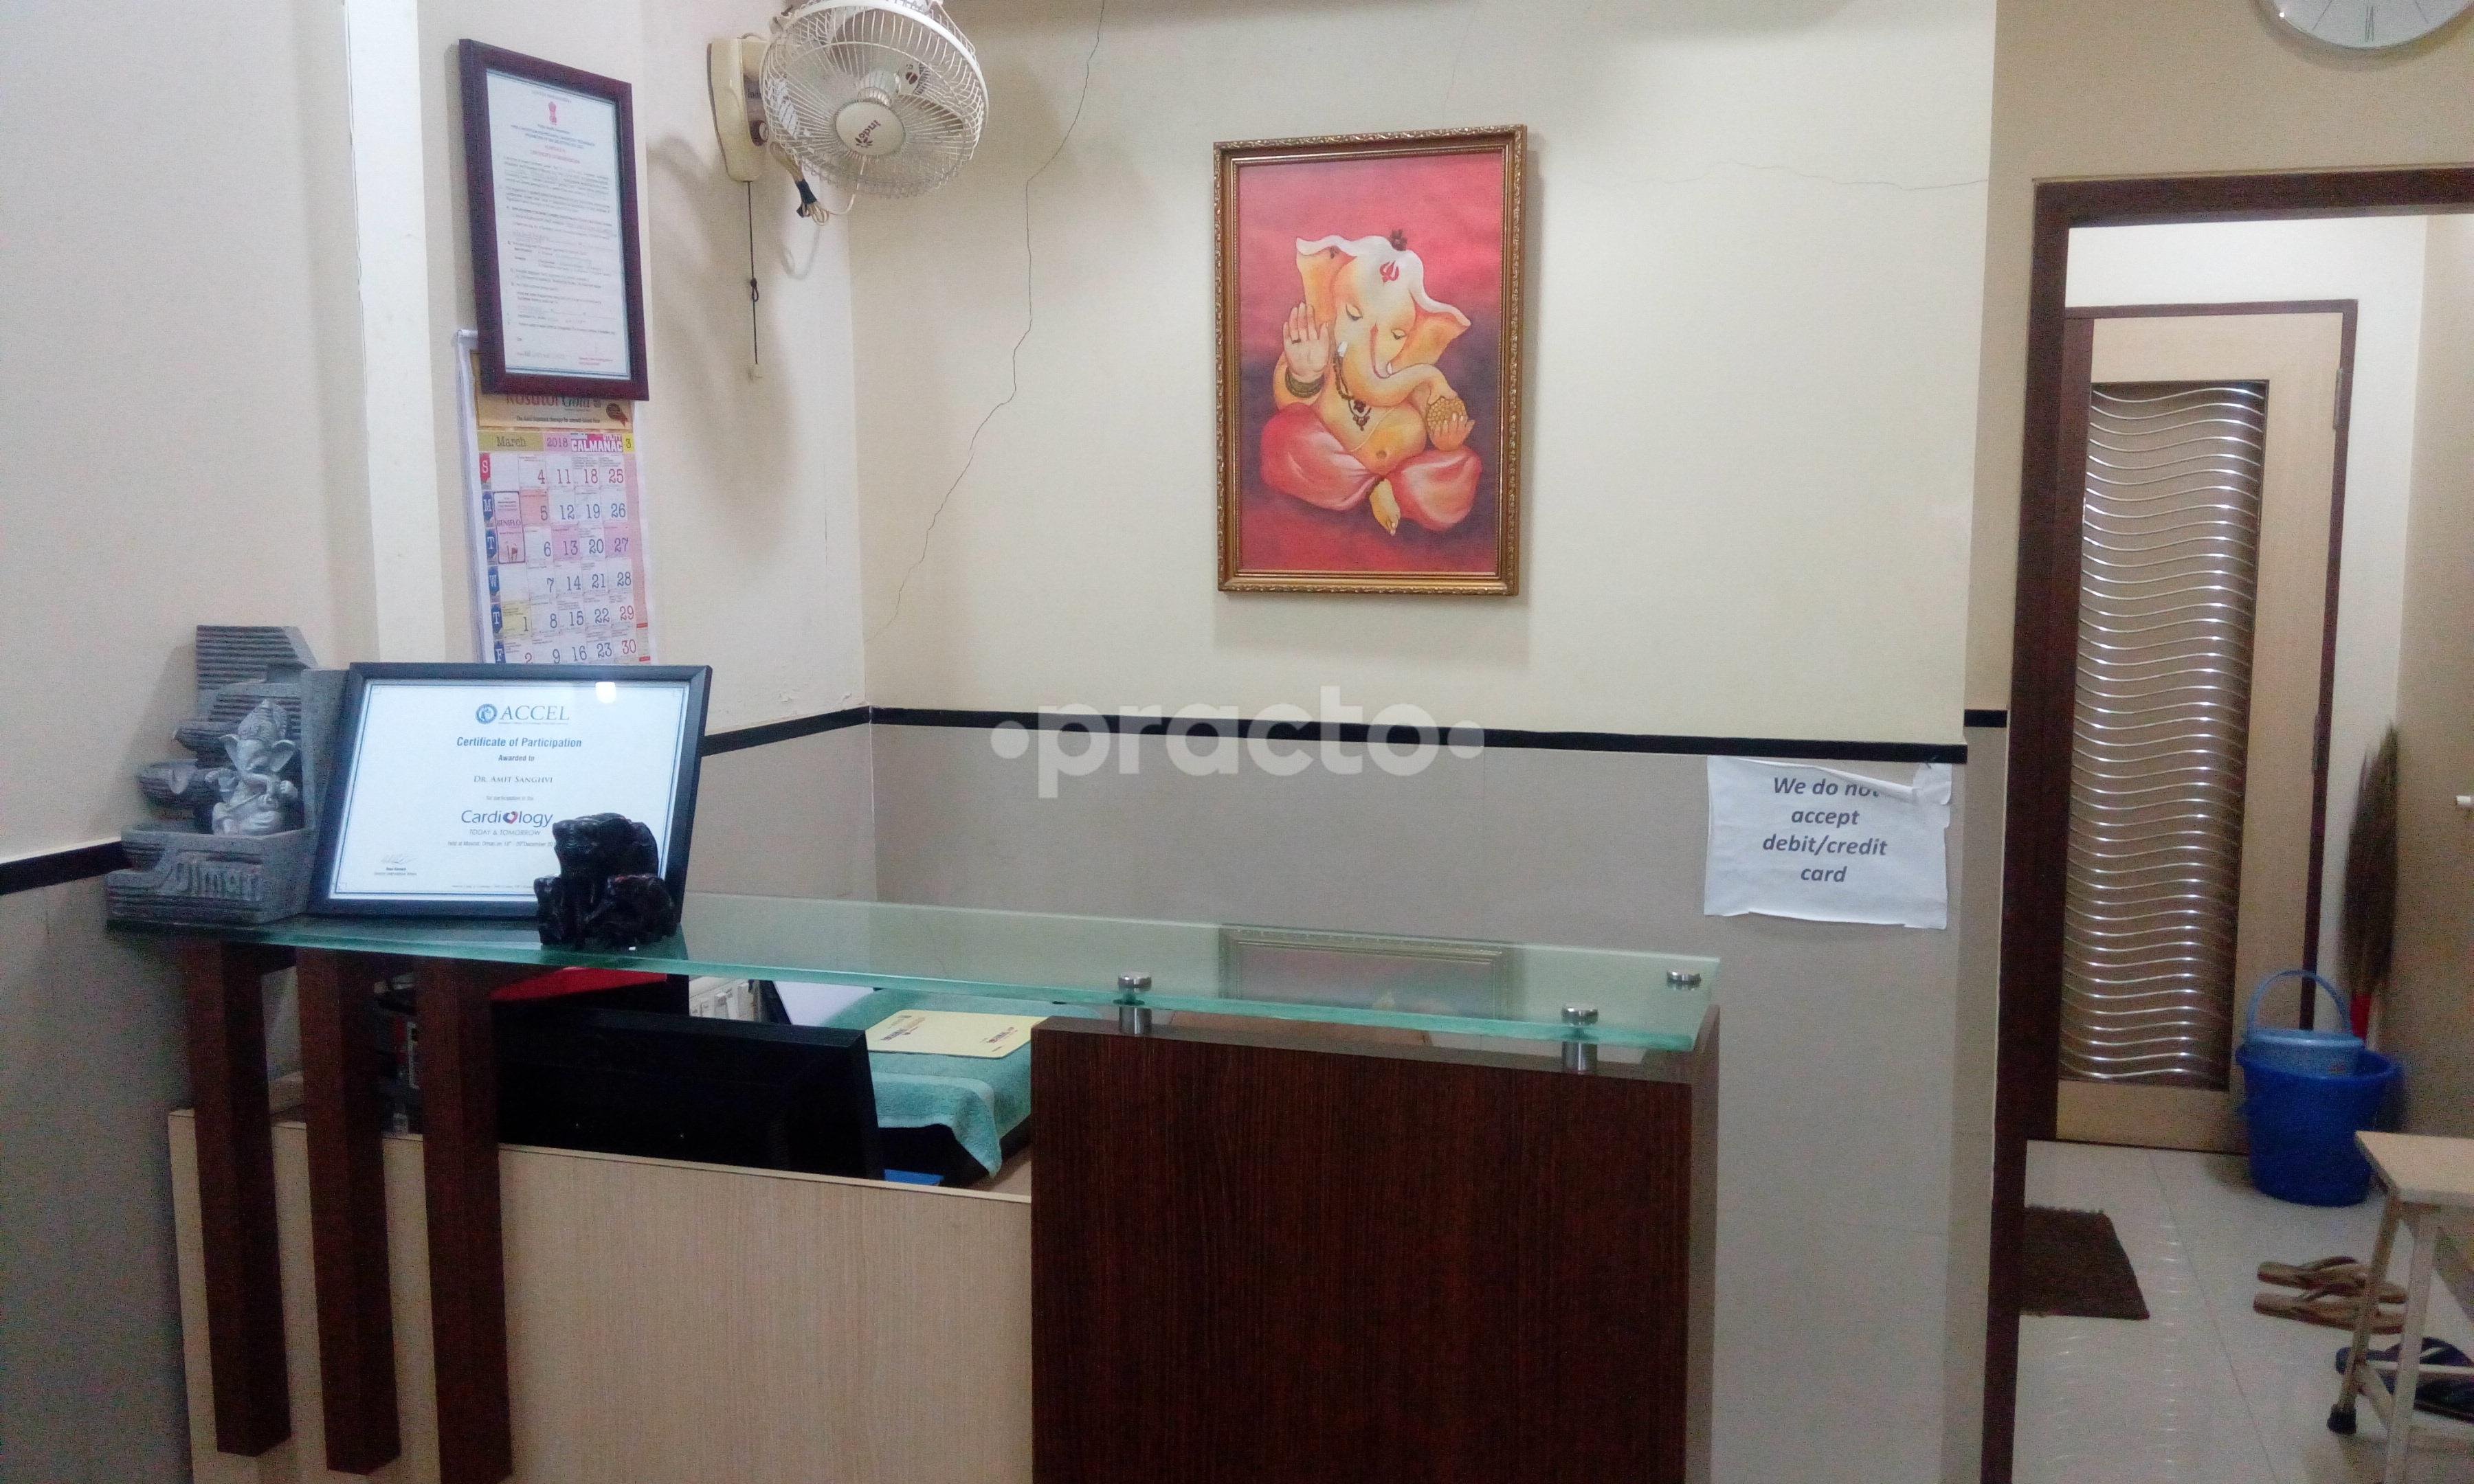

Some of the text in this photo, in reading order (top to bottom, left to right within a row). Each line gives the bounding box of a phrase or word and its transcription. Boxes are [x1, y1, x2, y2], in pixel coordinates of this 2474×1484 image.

[496, 436, 568, 447] March 2018
[572, 438, 632, 452] CALMANAC 3
[482, 460, 624, 484] S 4 11 18 25
[540, 505, 548, 521] 5
[559, 504, 575, 520] 12
[586, 504, 601, 519] 19
[610, 503, 626, 518] 26
[487, 536, 629, 557] T 6 13 20 27
[547, 577, 555, 593] 7
[566, 576, 581, 591] 14
[592, 574, 605, 588] 21
[617, 572, 632, 587] 28
[493, 605, 634, 631] T 1 8 15 22 29
[495, 639, 636, 664] F 2 9 16 23 30
[500, 705, 570, 721] ACCEL
[456, 737, 582, 749] Certificate of Participation
[1773, 777, 1807, 795] We
[1812, 778, 1838, 796] do
[1791, 809, 1860, 829] accept
[1763, 833, 1888, 856] debit/credit
[1800, 866, 1848, 883] card
